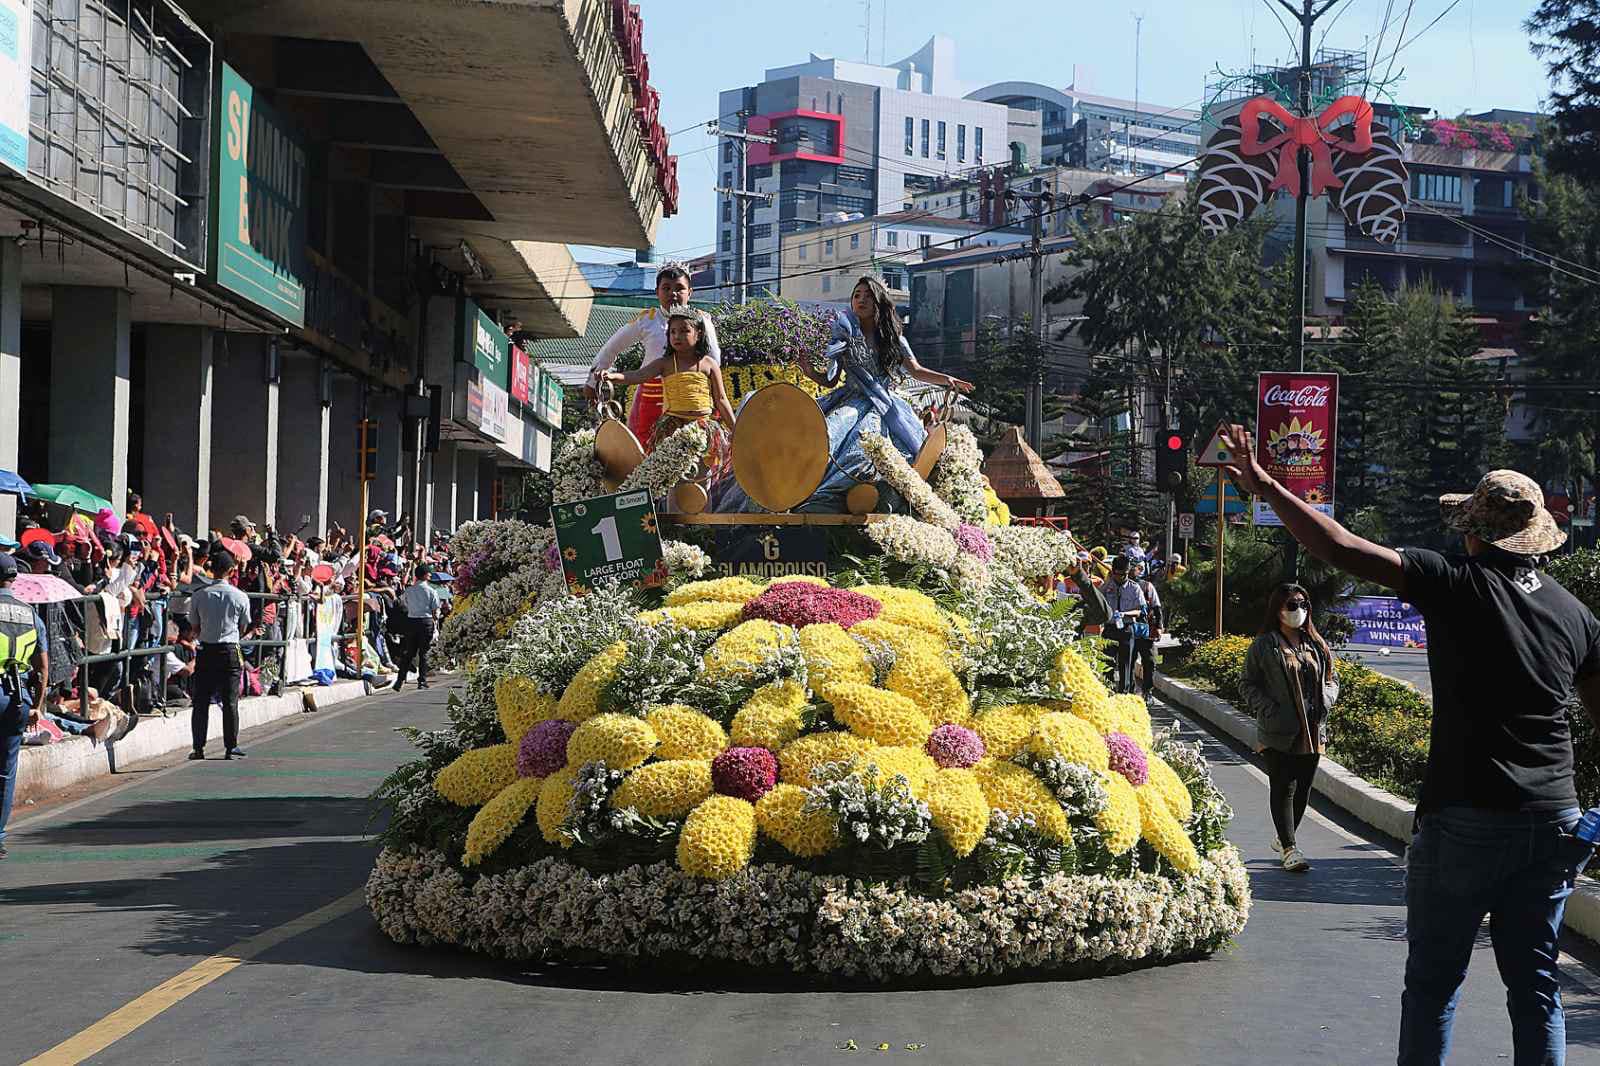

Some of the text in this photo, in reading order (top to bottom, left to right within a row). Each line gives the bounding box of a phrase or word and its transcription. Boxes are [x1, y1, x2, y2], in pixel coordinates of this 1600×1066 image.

[227, 90, 306, 208] SUMMIT
[239, 175, 294, 274] BANK
[591, 515, 624, 562] 1
[584, 558, 645, 578] LARGE FLOAT
[1376, 609, 1402, 619] 2024
[1350, 619, 1426, 632] FESTIVAL DANC
[1369, 631, 1411, 641] WINNER
